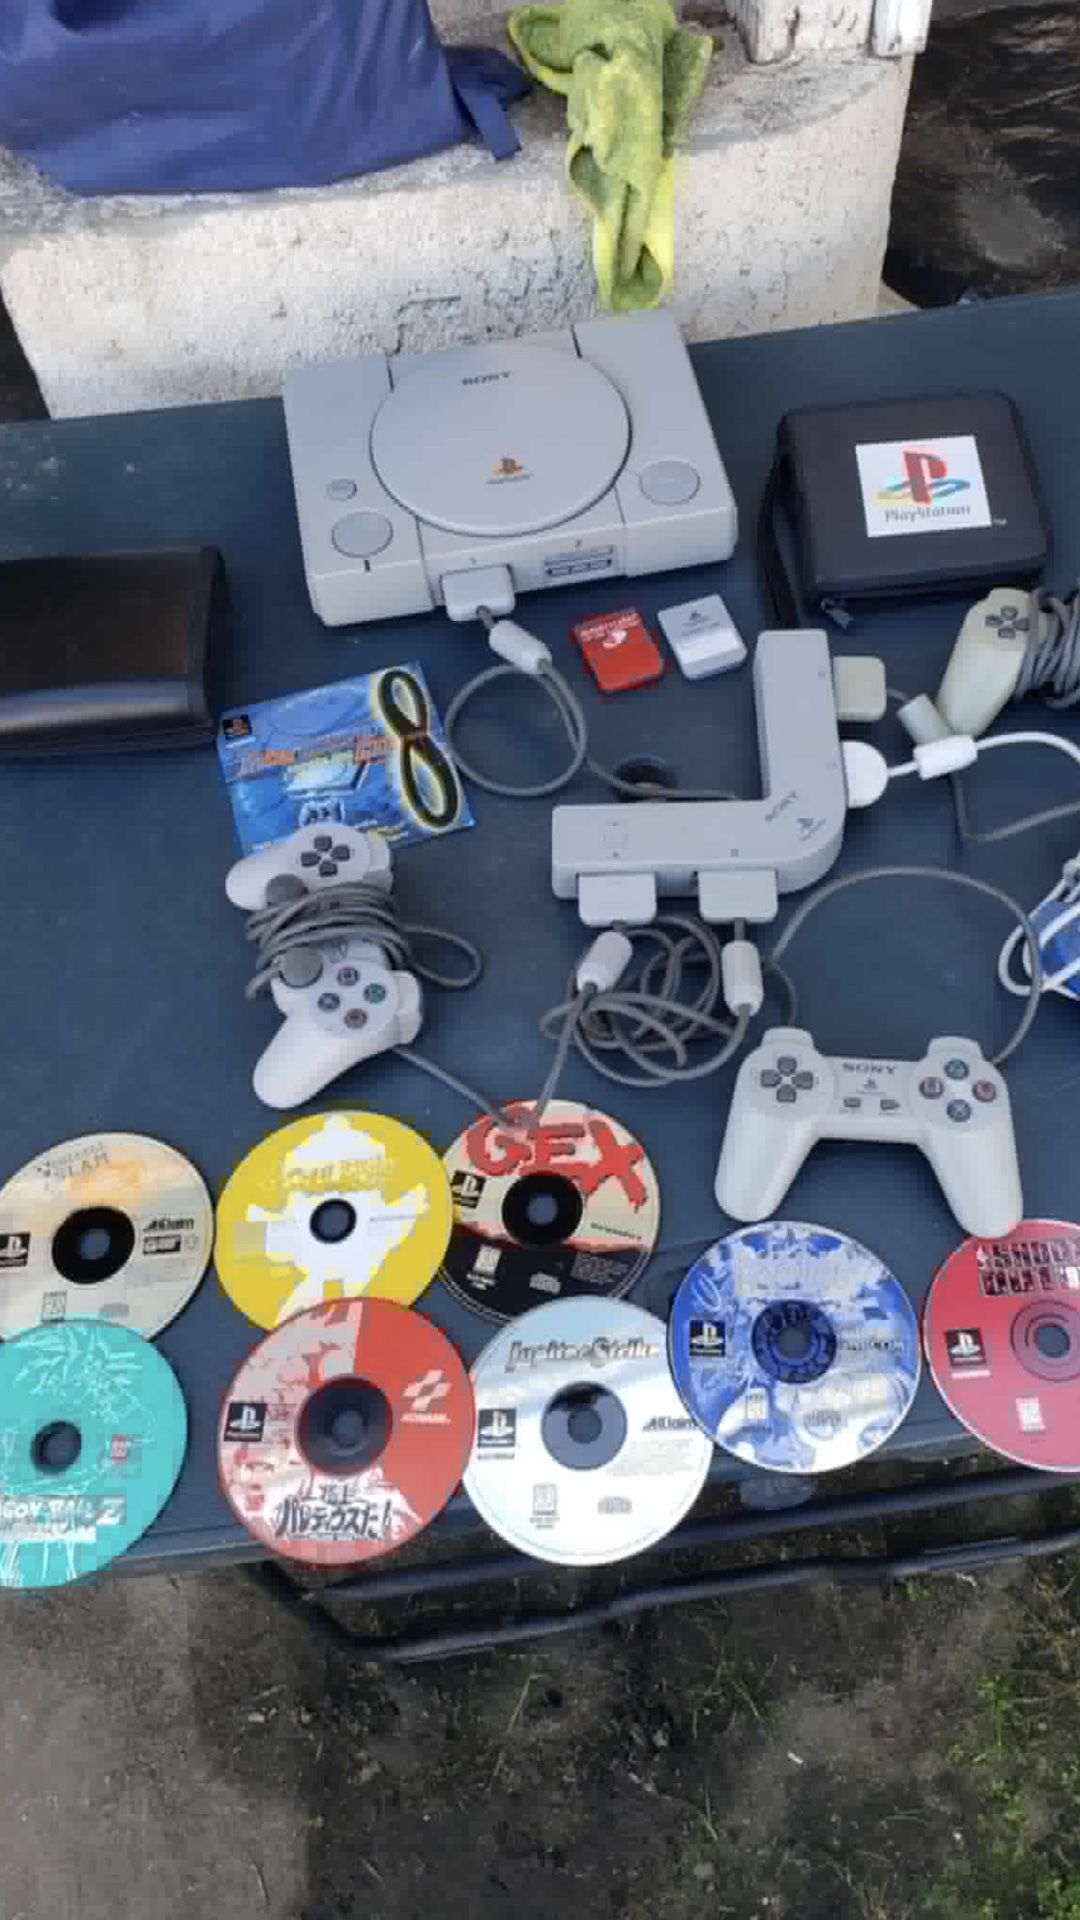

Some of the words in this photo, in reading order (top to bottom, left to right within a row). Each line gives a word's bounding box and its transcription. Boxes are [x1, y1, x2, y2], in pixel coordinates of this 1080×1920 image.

[885, 504, 971, 524] PlayStation
[841, 1062, 898, 1076] SONY
[462, 1103, 647, 1212] GEX
